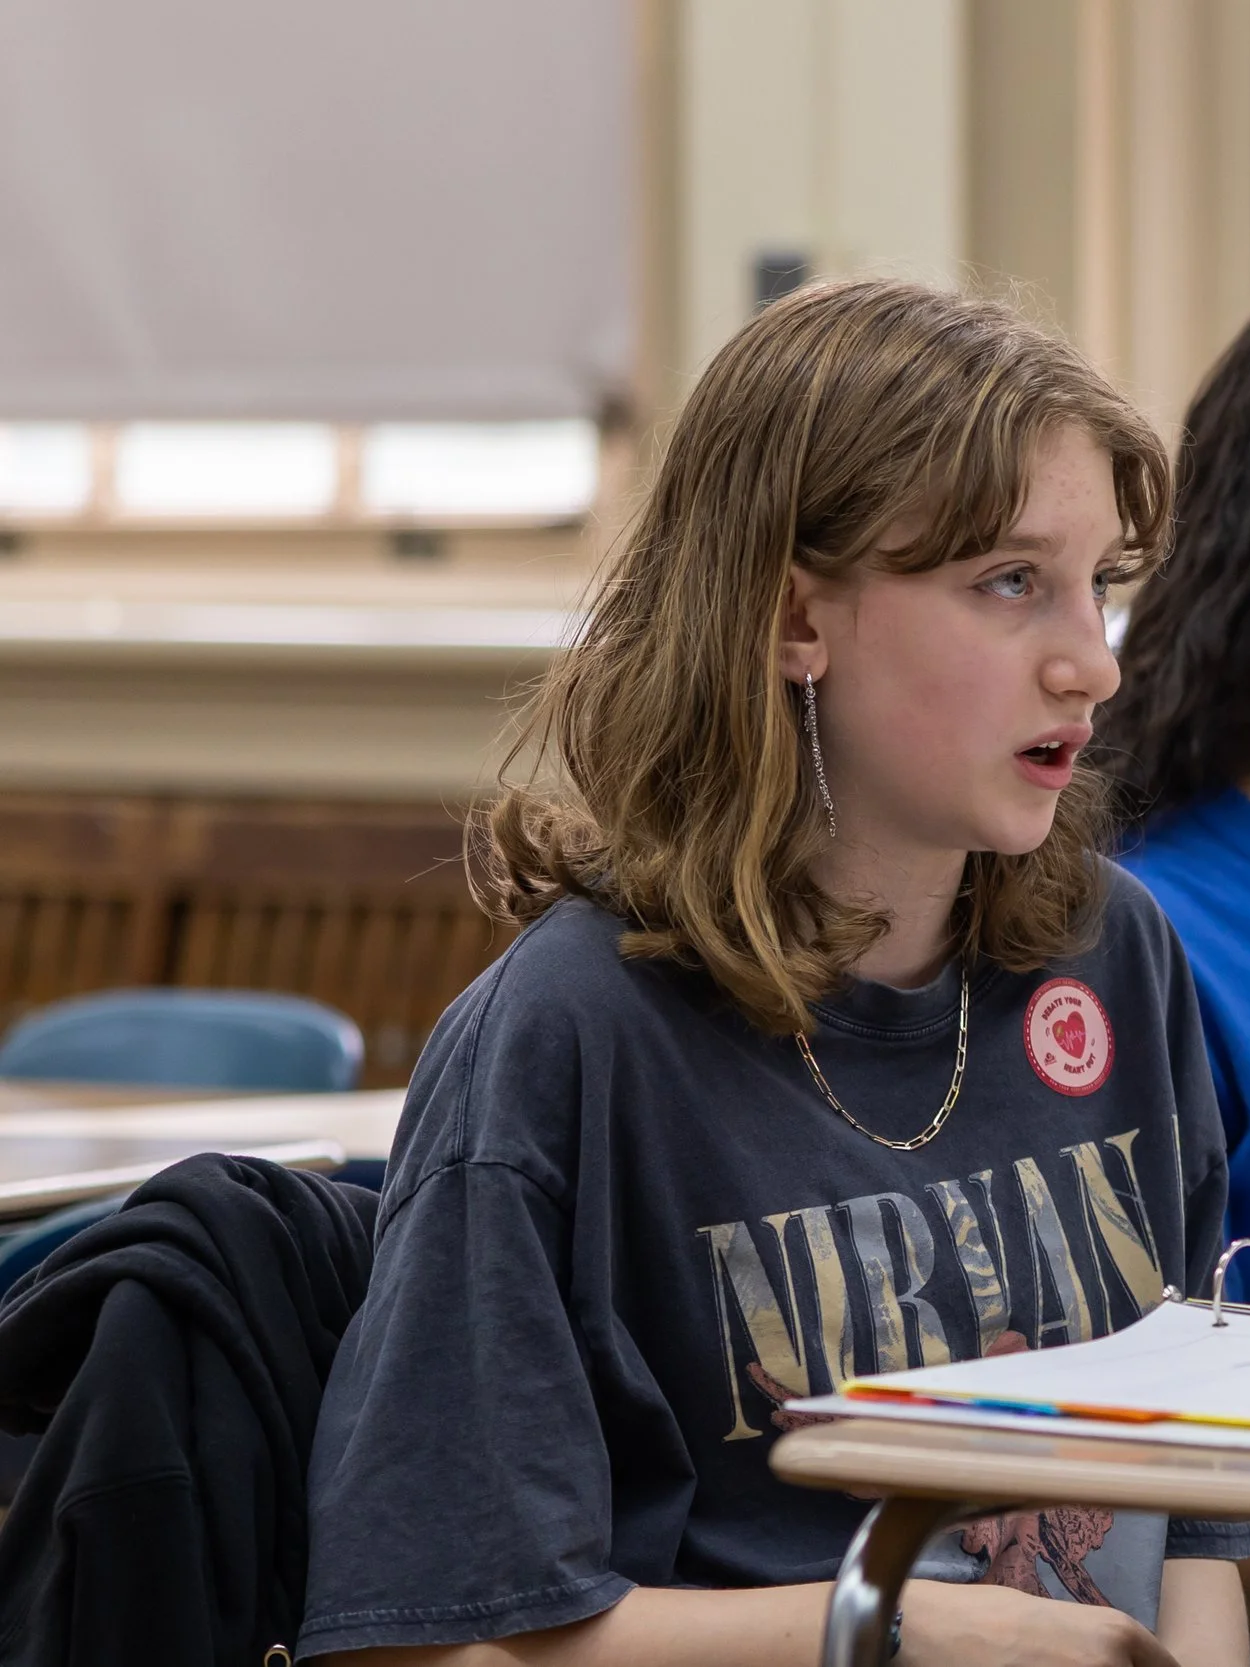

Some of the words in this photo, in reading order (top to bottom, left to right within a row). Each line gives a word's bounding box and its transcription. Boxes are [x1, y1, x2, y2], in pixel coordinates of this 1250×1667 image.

[1041, 997, 1063, 1020] DEBATE
[1064, 997, 1082, 1007] YOUR
[1063, 1063, 1085, 1074] HEART
[1086, 1053, 1096, 1069] OUT
[696, 1114, 1185, 1442] NIRVAN
